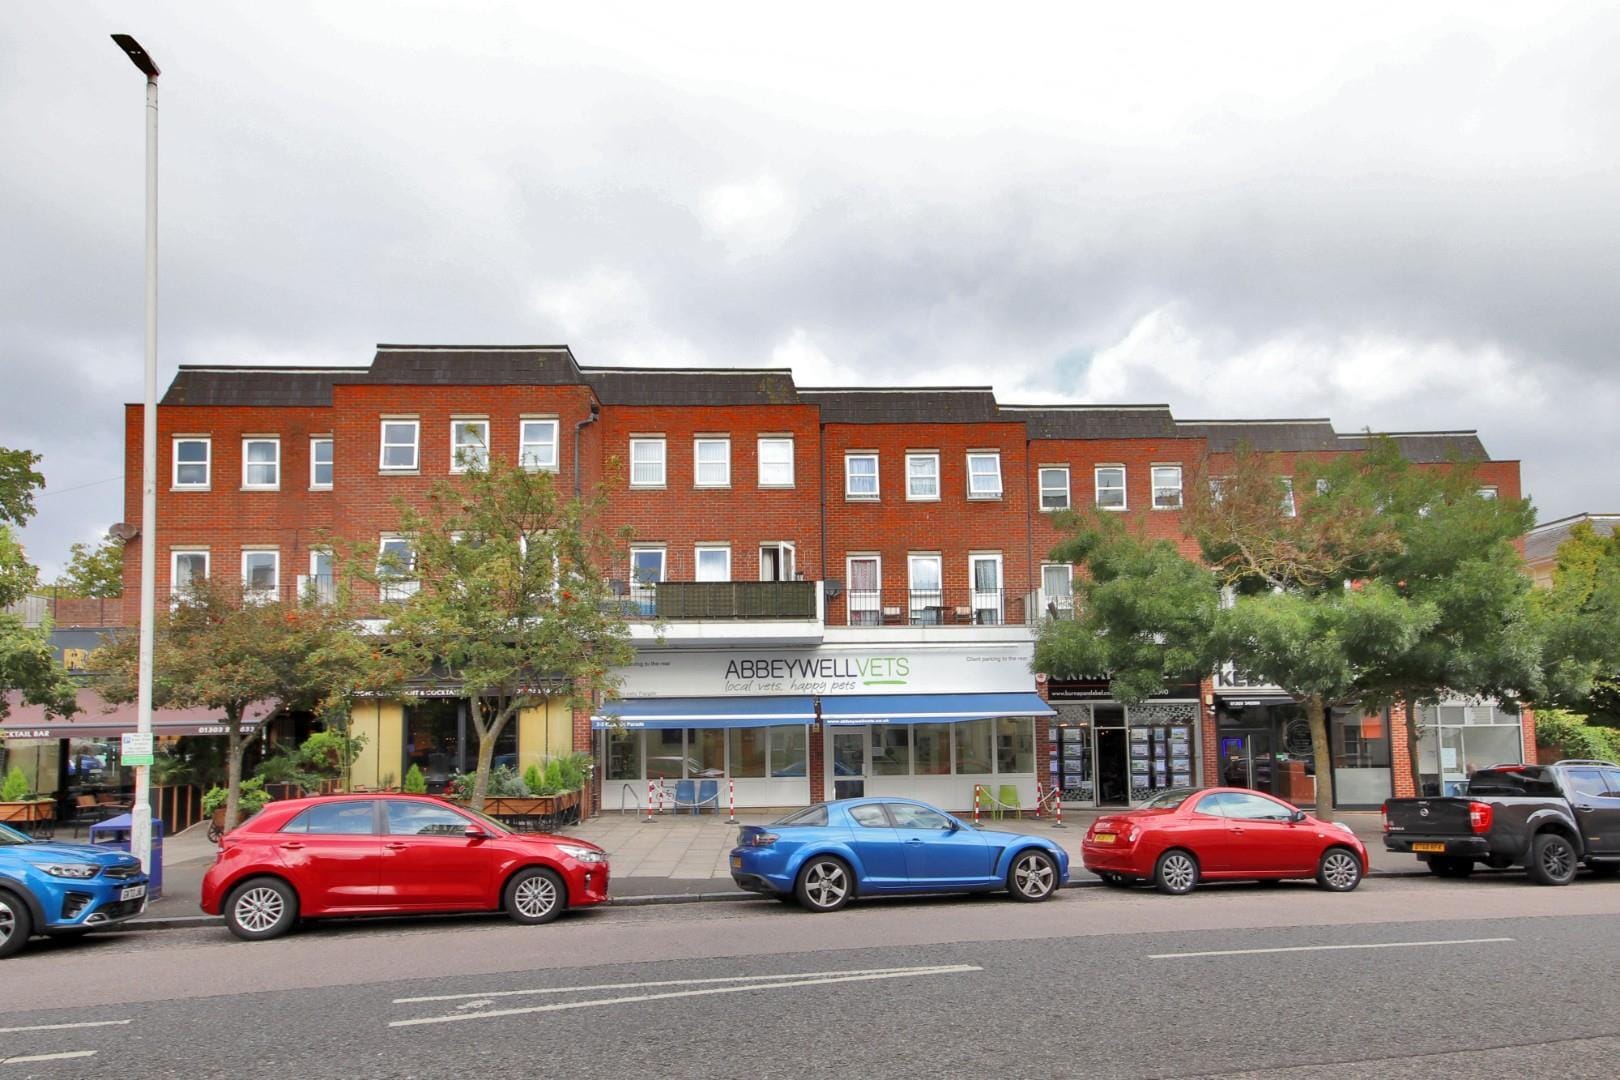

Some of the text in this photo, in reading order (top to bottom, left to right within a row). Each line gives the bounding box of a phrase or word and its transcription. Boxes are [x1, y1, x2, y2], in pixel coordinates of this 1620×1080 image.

[725, 680, 752, 692] local
[790, 680, 828, 692] happy
[830, 680, 857, 693] pets
